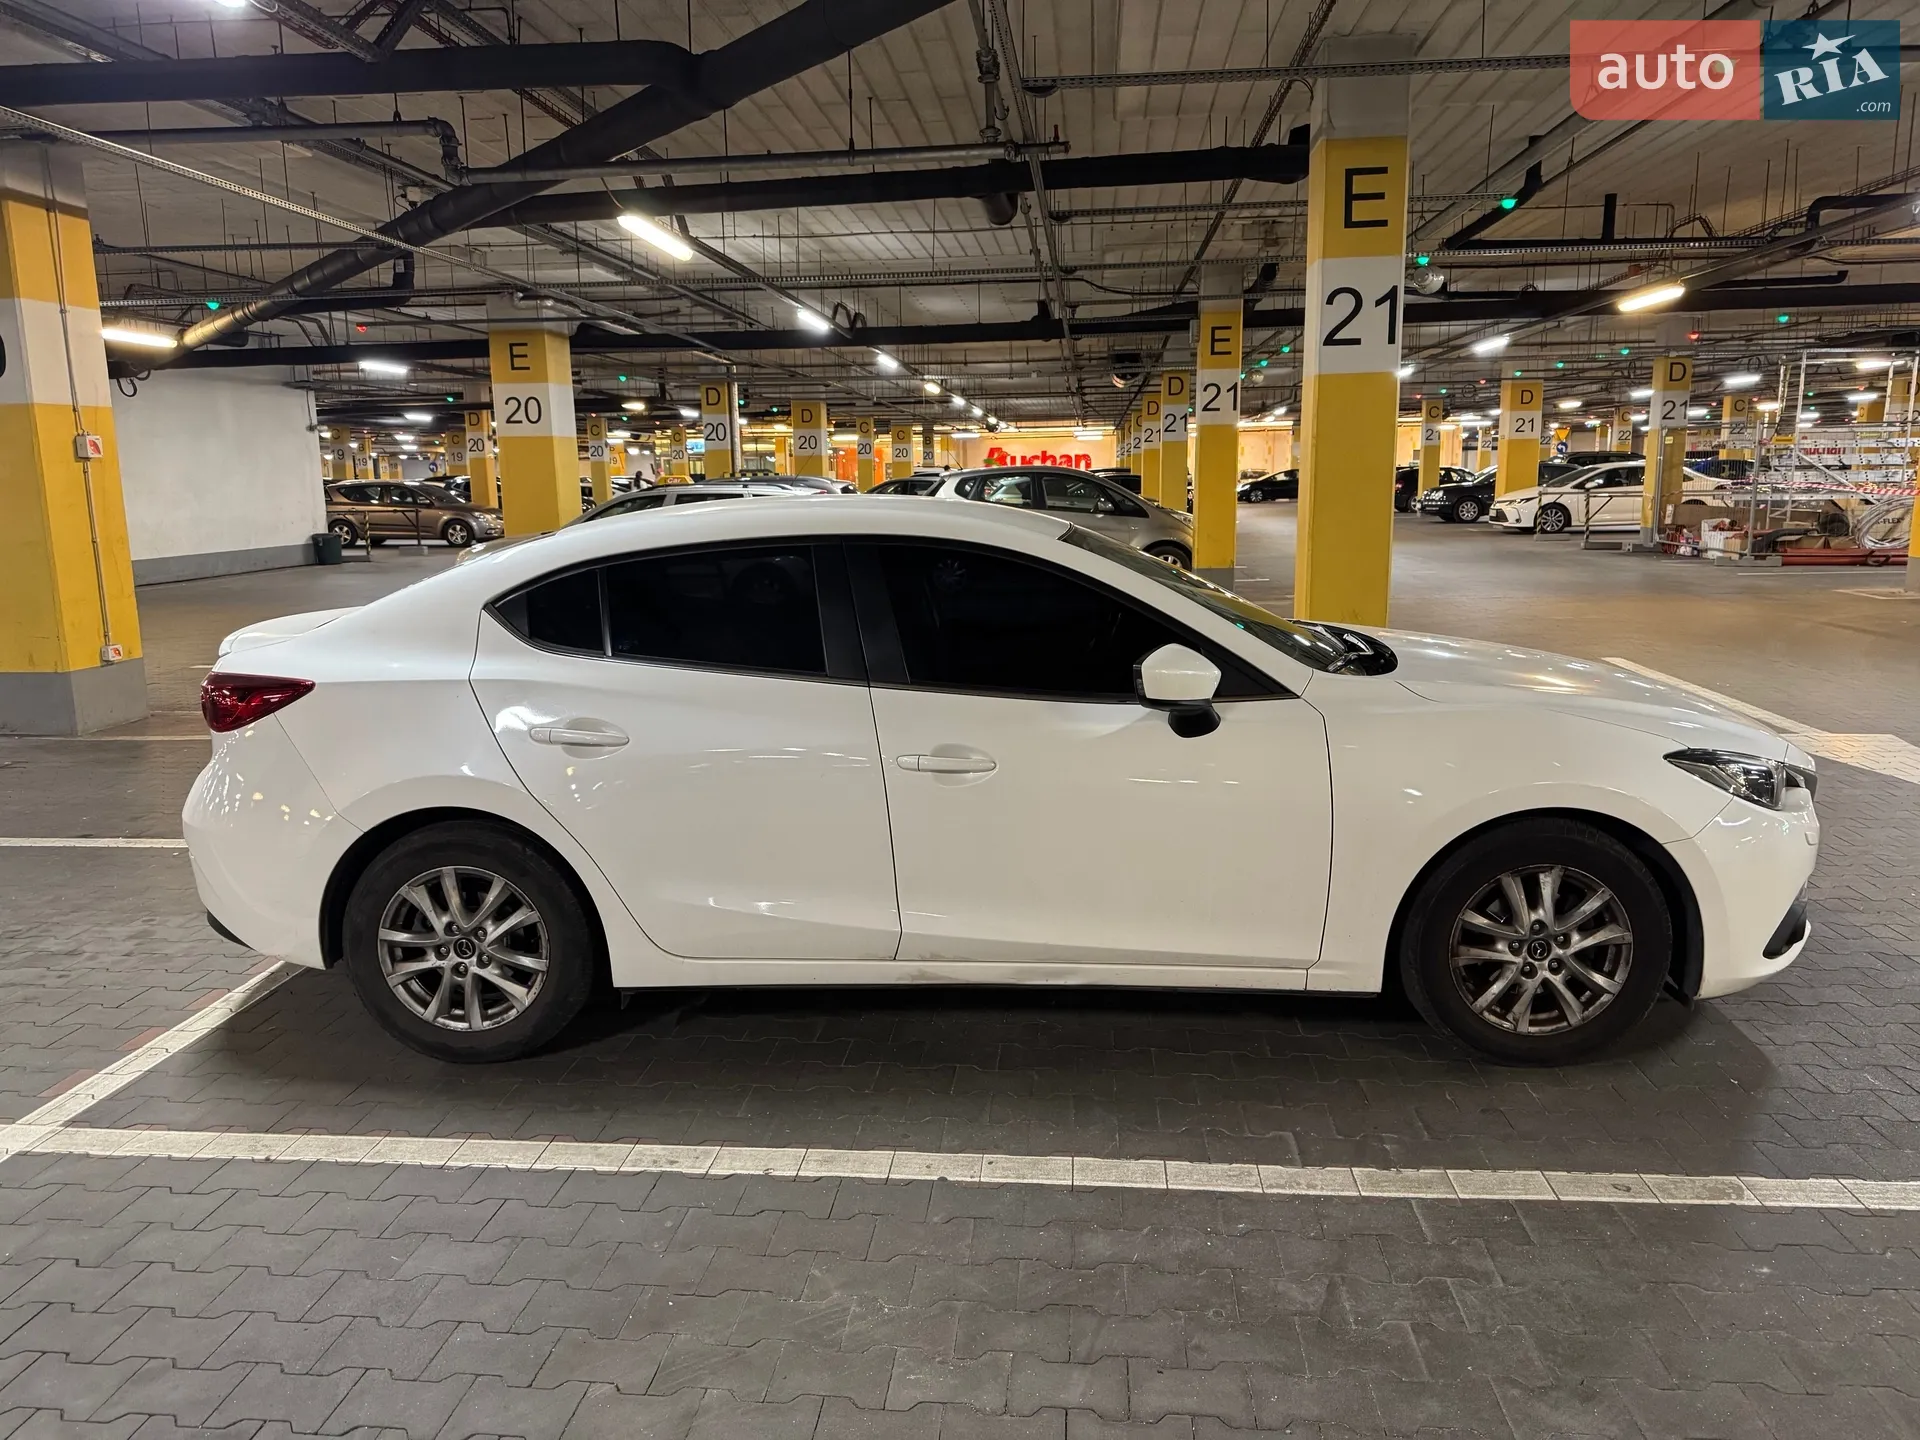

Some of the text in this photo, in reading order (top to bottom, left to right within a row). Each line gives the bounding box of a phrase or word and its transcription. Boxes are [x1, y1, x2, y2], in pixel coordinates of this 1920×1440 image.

[1343, 166, 1389, 229] E
[1322, 284, 1398, 347] 21
[1210, 325, 1232, 356] E
[508, 342, 530, 371] E
[1668, 361, 1687, 382] D
[1168, 376, 1184, 396] D
[706, 387, 721, 406] D
[1201, 381, 1238, 412] 21
[1520, 389, 1534, 404] D
[504, 396, 542, 425] 20
[1147, 400, 1159, 415] D
[1429, 406, 1440, 418] C
[1661, 400, 1688, 420] 21
[1734, 400, 1746, 412] C
[468, 413, 480, 426] D
[801, 408, 813, 423] D
[1621, 411, 1631, 422] C
[859, 422, 870, 434] C
[1163, 413, 1187, 433] 21
[1515, 417, 1535, 433] 21
[332, 428, 341, 440] C
[590, 424, 600, 437] C
[673, 432, 682, 442] C
[704, 422, 727, 442] 20
[896, 430, 906, 441] C
[1144, 427, 1161, 443] 21
[1617, 430, 1631, 441] 22
[451, 434, 460, 445] C
[468, 438, 484, 453] 20
[798, 435, 818, 450] 20
[1133, 436, 1142, 449] 2
[331, 448, 345, 461] 19
[590, 445, 604, 457] 20
[672, 449, 684, 460] 20
[857, 443, 872, 455] 20
[895, 447, 908, 458] 20
[924, 451, 934, 460] 20
[357, 458, 368, 467] 19
[451, 452, 463, 462] 19
[984, 446, 1092, 471] Auchan
